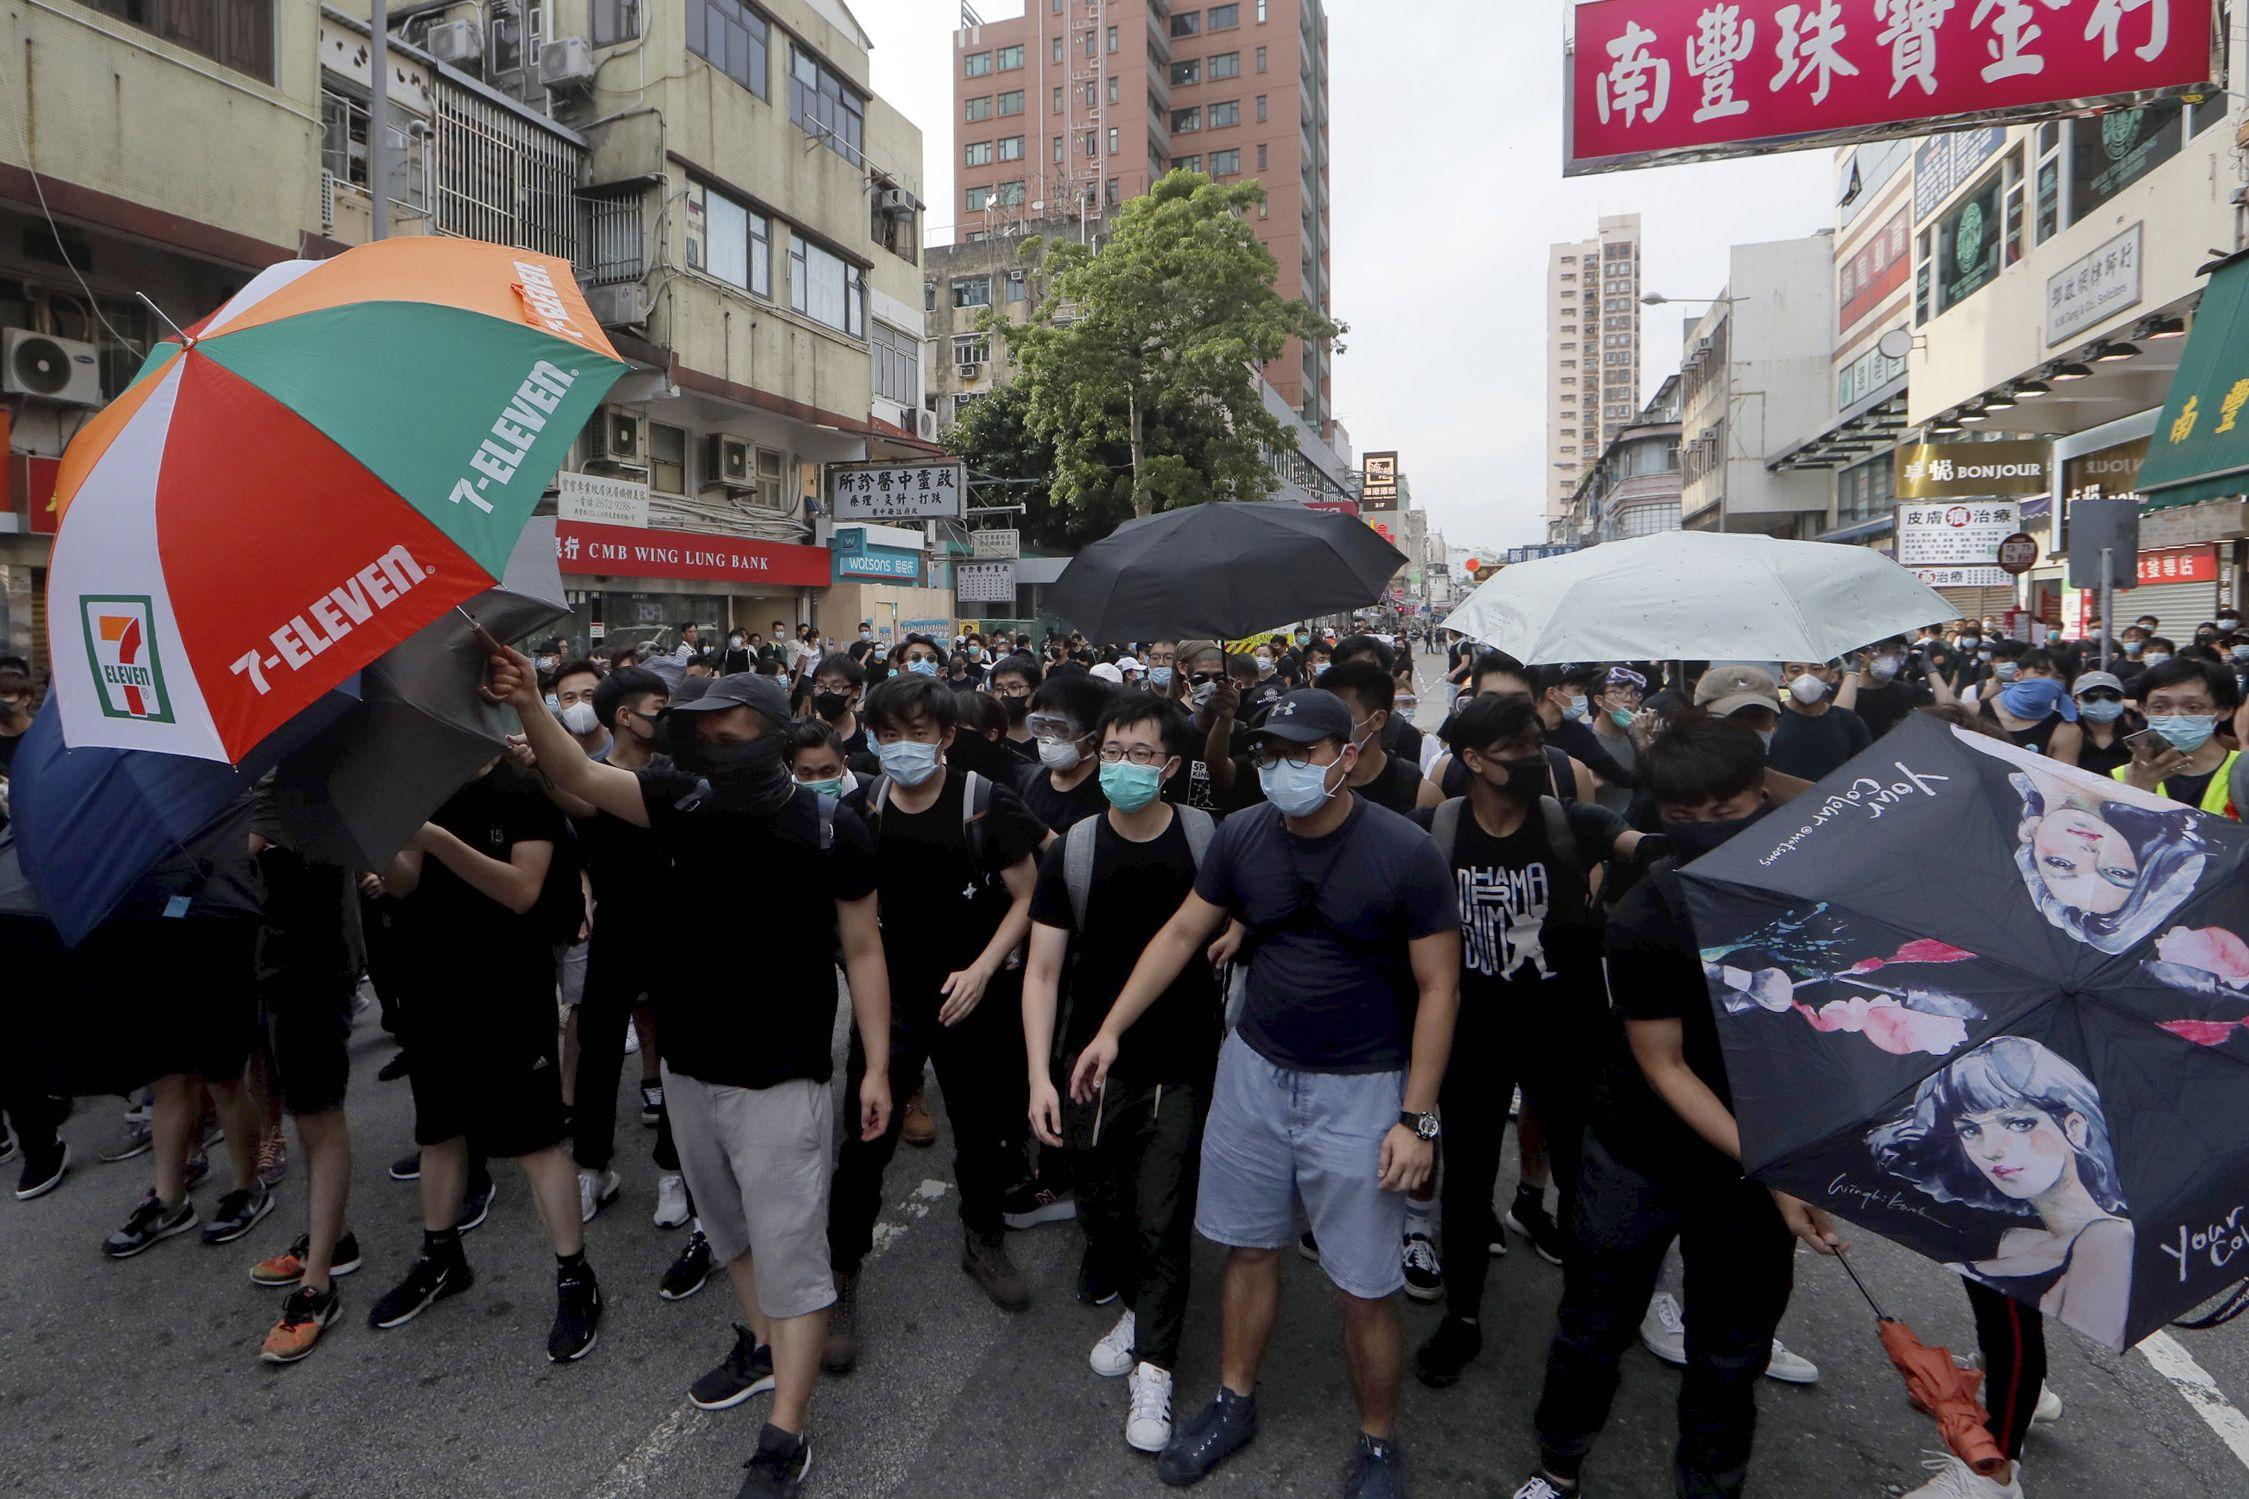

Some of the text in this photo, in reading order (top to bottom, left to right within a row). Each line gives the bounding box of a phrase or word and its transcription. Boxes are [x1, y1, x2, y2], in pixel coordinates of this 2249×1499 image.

[1595, 0, 2170, 128] 南豐珠寶金行
[1957, 463, 2041, 480] BONJOUR
[588, 542, 628, 560] CMB
[634, 546, 679, 564] WING
[685, 550, 726, 567] LUNG
[731, 555, 769, 570] BANK
[849, 557, 891, 572] watsons
[1193, 762, 1208, 771] SP
[1812, 778, 1881, 826] Colour
[1868, 761, 1950, 819] Your
[2160, 1205, 2244, 1282] Your
[2210, 1225, 2249, 1267] Col
